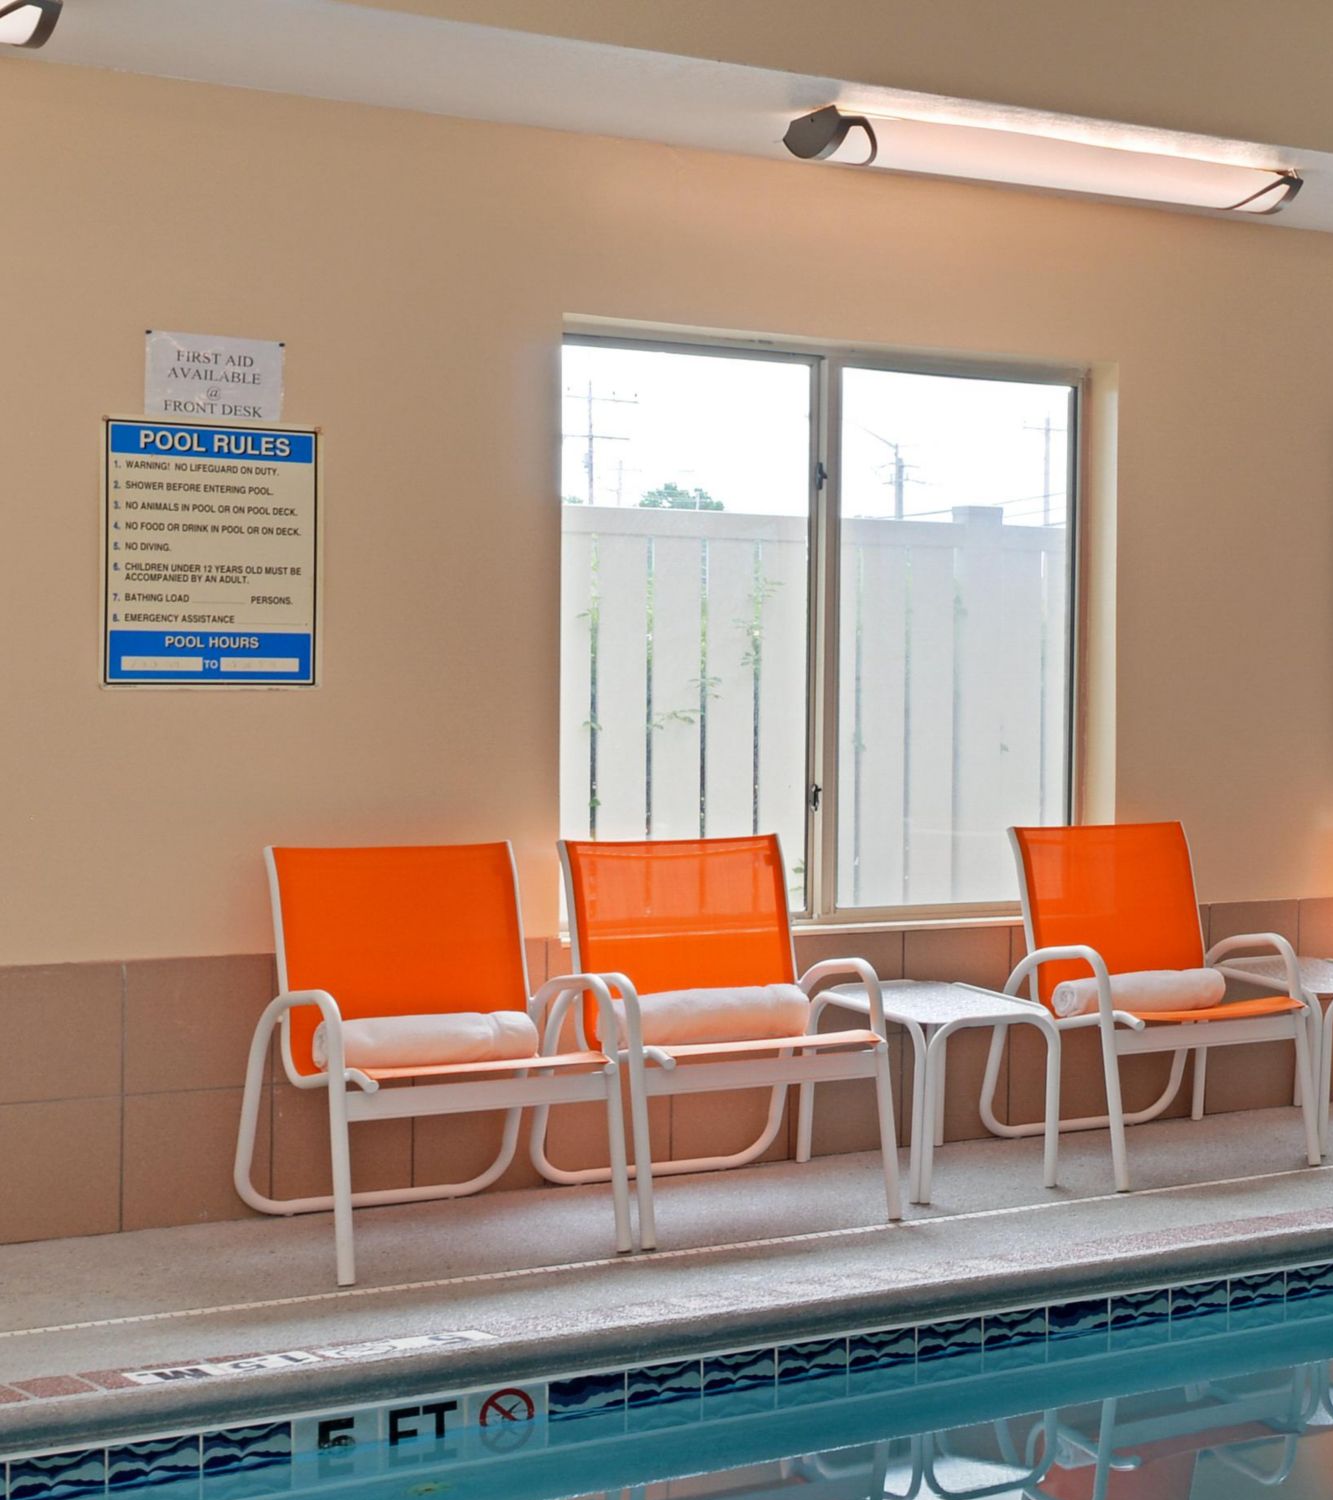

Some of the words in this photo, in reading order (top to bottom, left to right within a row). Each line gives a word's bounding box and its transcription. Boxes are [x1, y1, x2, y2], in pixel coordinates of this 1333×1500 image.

[177, 350, 220, 365] FIRST
[225, 354, 254, 368] AID
[167, 367, 261, 385] AVAILABLE
[206, 387, 221, 400] @
[164, 399, 218, 415] FRONT
[222, 403, 263, 418] DESK
[139, 429, 208, 454] POOL
[213, 434, 291, 459] RULES
[114, 460, 121, 468] 1.
[126, 460, 170, 471] WARNING!
[174, 463, 188, 472] NO
[190, 464, 238, 474] LIFEGUARD
[240, 466, 253, 474] ON
[254, 467, 279, 476] DUTY.
[125, 480, 164, 490] SHOWER
[166, 482, 201, 492] BEFORE
[204, 484, 246, 494] ENTERING
[248, 486, 274, 496] POOL.
[125, 501, 138, 510] NO
[140, 502, 179, 512] ANIMALS
[181, 504, 190, 512] IN
[192, 504, 216, 513] POOL
[218, 504, 230, 514] OR
[232, 505, 245, 514] ON
[247, 506, 270, 516] POOL
[272, 507, 298, 516] DECK.
[125, 522, 138, 530] NO
[140, 522, 165, 532] FOOD
[167, 523, 180, 532] OR
[182, 524, 208, 533] DRINK
[210, 525, 219, 533] IN
[221, 525, 245, 534] POOL
[246, 526, 260, 535] OR
[261, 526, 274, 536] ON
[276, 527, 302, 536] DECK.
[125, 542, 138, 550] NO
[140, 542, 172, 552] DIVING.
[124, 562, 169, 572] CHILDREN
[170, 564, 201, 573] UNDER
[204, 564, 212, 573] 12
[214, 565, 243, 574] YEARS
[245, 566, 262, 574] OLD
[264, 566, 288, 575] MUST
[290, 567, 302, 576] BE
[124, 572, 189, 583] ACCOMPANIED
[190, 574, 202, 582] BY
[204, 575, 217, 583] AN
[219, 576, 250, 584] ADULT.
[124, 592, 163, 602] BATHING
[165, 594, 190, 602] LOAD
[250, 596, 293, 605] PERSONS.
[124, 612, 179, 623] EMERGENCY
[181, 614, 235, 624] ASSISTANCE
[164, 635, 204, 649] POOL
[208, 636, 260, 650] HOURS
[204, 659, 218, 669] TO
[389, 1400, 458, 1447] FT
